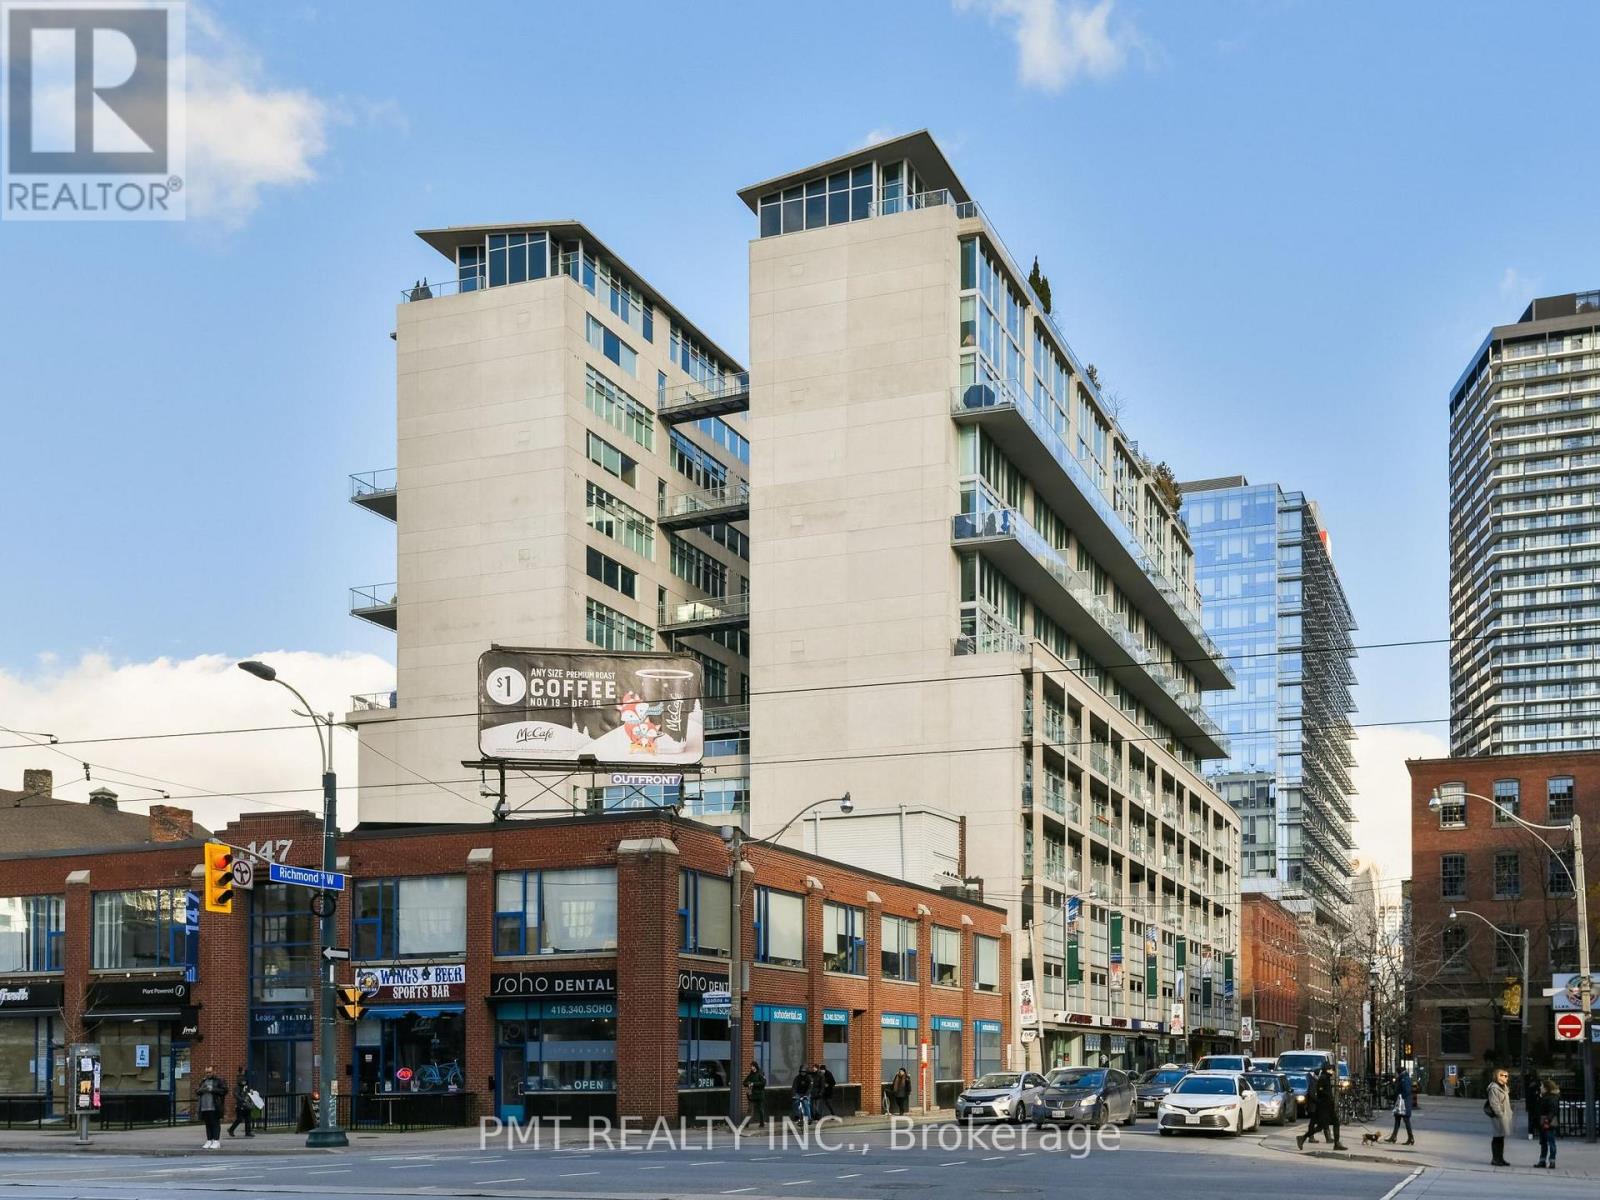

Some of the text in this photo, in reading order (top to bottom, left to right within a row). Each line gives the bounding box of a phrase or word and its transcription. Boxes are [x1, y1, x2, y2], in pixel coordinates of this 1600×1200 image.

[531, 668, 615, 680] ANY SIZE PREMIUM ROAST
[496, 675, 511, 697] $1
[530, 679, 616, 699] COFFEE
[530, 698, 547, 707] NOV
[551, 698, 560, 707] 19
[572, 700, 589, 708] DEC
[613, 774, 678, 785] OUTFRONT
[247, 840, 293, 864] 147
[279, 867, 318, 883] Richmond
[326, 874, 334, 885] W
[186, 890, 199, 935] 147
[380, 967, 419, 984] WINGS
[434, 967, 462, 983] BEER
[494, 971, 615, 993] soho DENTAL
[393, 986, 428, 999] SPORTS
[431, 985, 450, 998] BAR
[709, 981, 729, 992] DENT
[551, 1004, 613, 1014] 416.340.SOHO
[574, 1080, 604, 1090] OPEN
